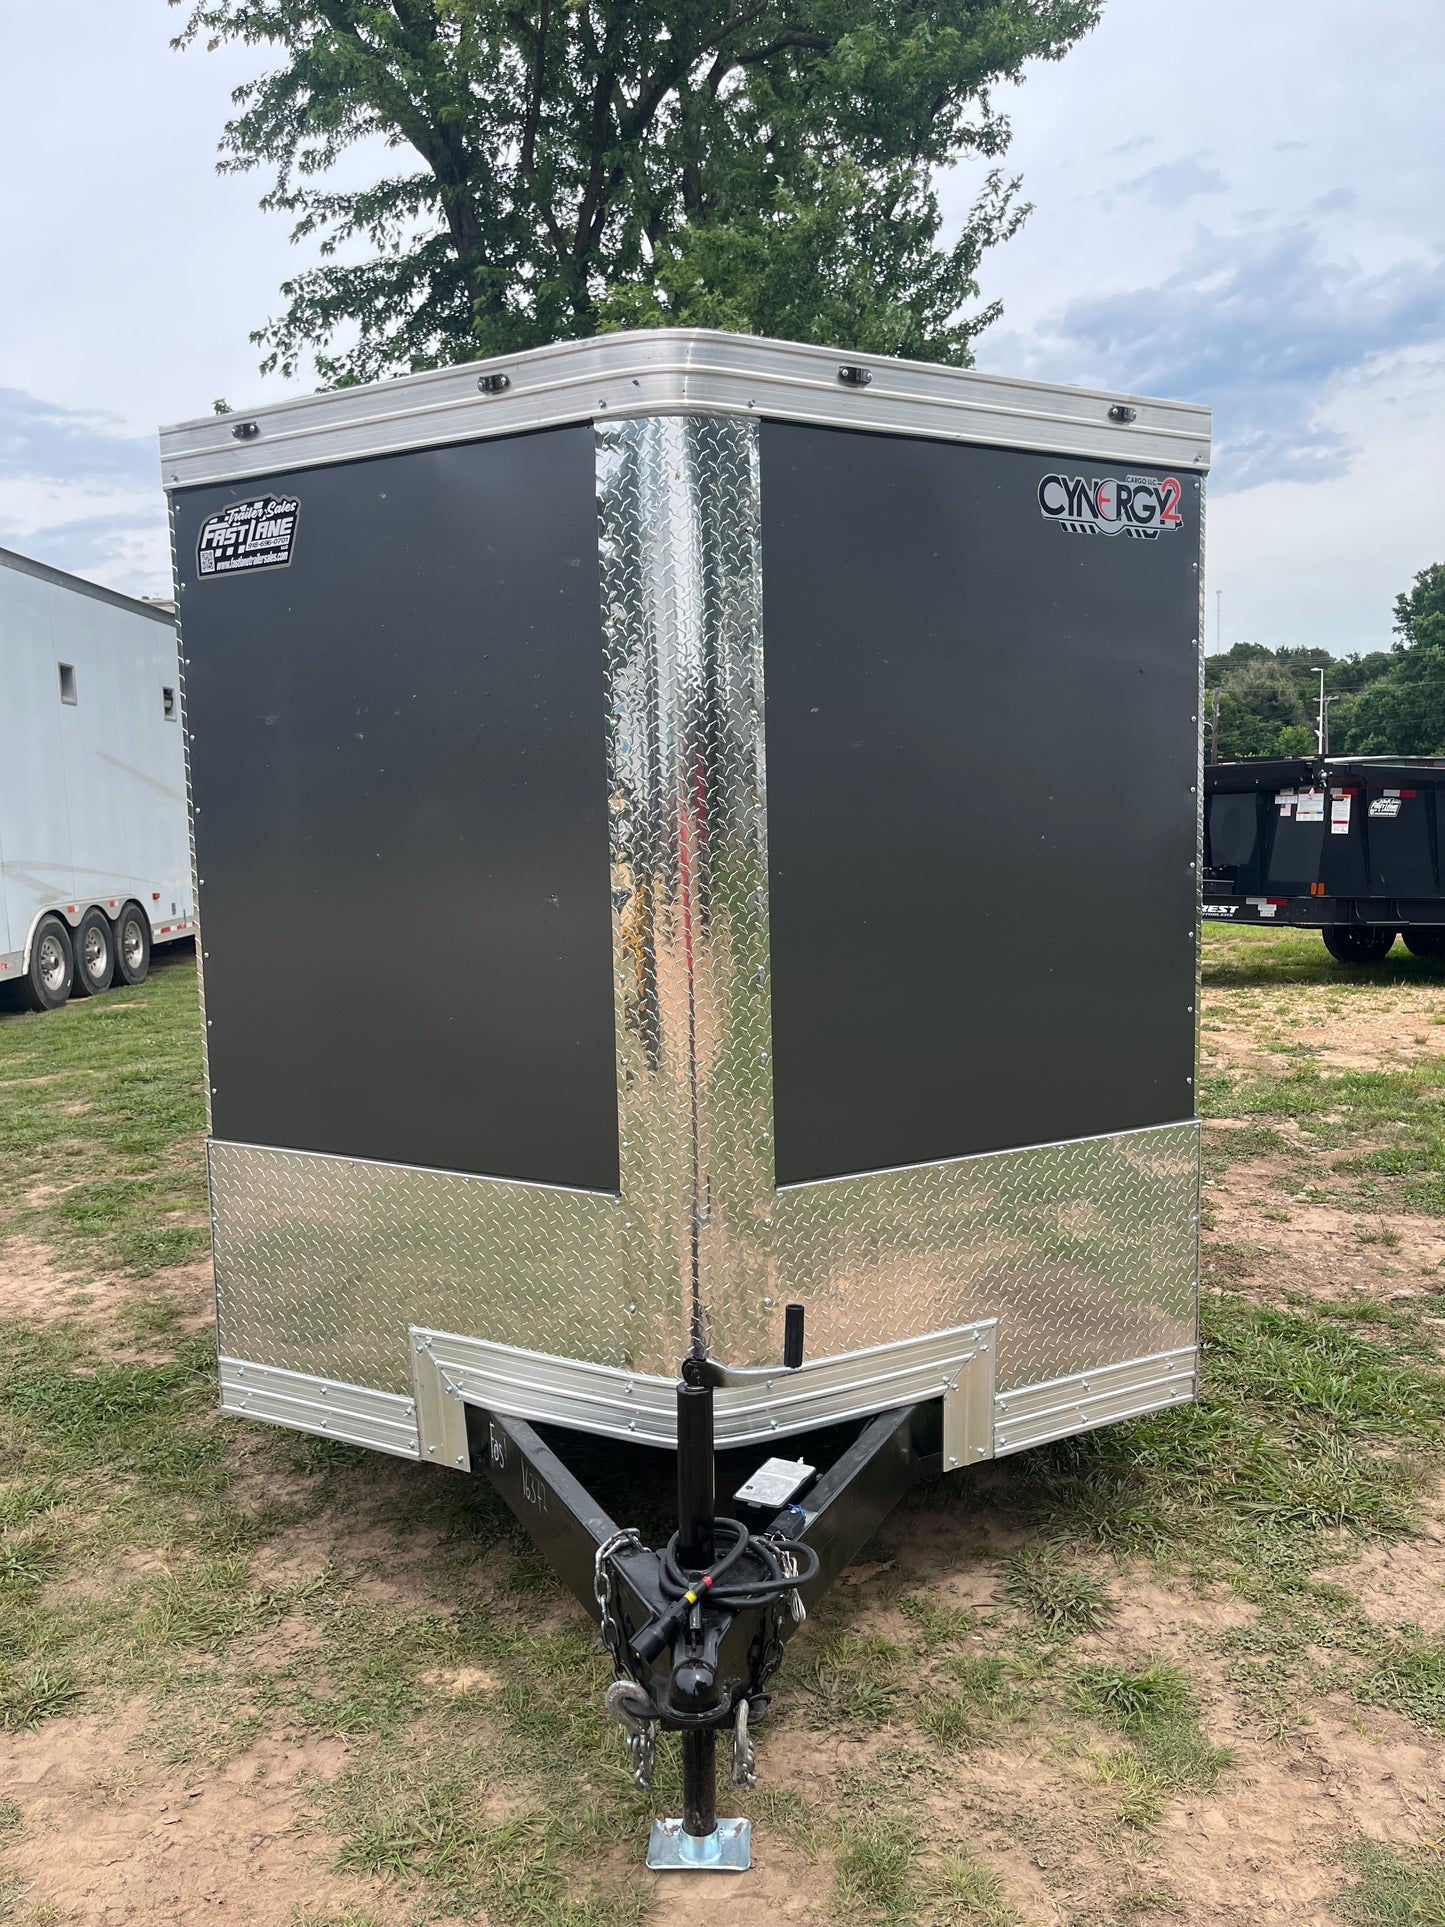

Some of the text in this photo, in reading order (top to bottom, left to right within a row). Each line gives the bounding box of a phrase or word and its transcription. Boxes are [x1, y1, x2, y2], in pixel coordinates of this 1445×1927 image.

[227, 501, 296, 524] Trailer Sales
[201, 517, 293, 550] FAST LANE
[248, 537, 288, 549] 918-696-0701
[217, 552, 288, 570] www.fastlanetrailersales.com
[1202, 905, 1239, 913] REST
